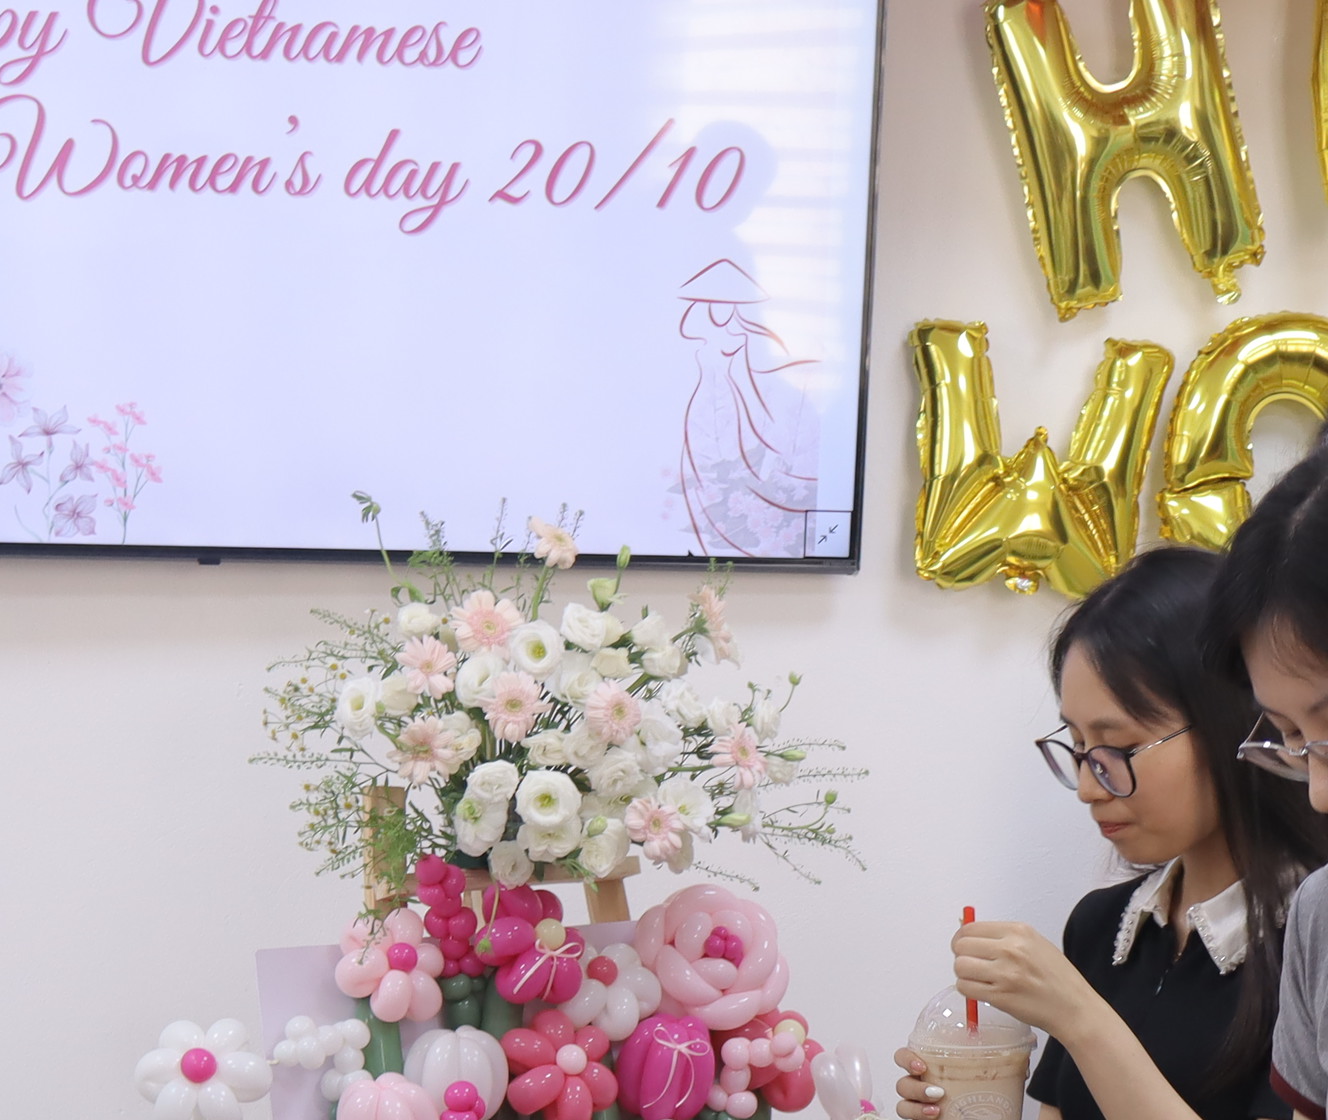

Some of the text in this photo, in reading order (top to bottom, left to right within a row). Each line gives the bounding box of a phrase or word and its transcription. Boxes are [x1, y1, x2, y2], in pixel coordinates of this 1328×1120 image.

[86, 0, 483, 69] Vietnamese
[343, 128, 469, 235] day
[488, 117, 748, 215] 20/10
